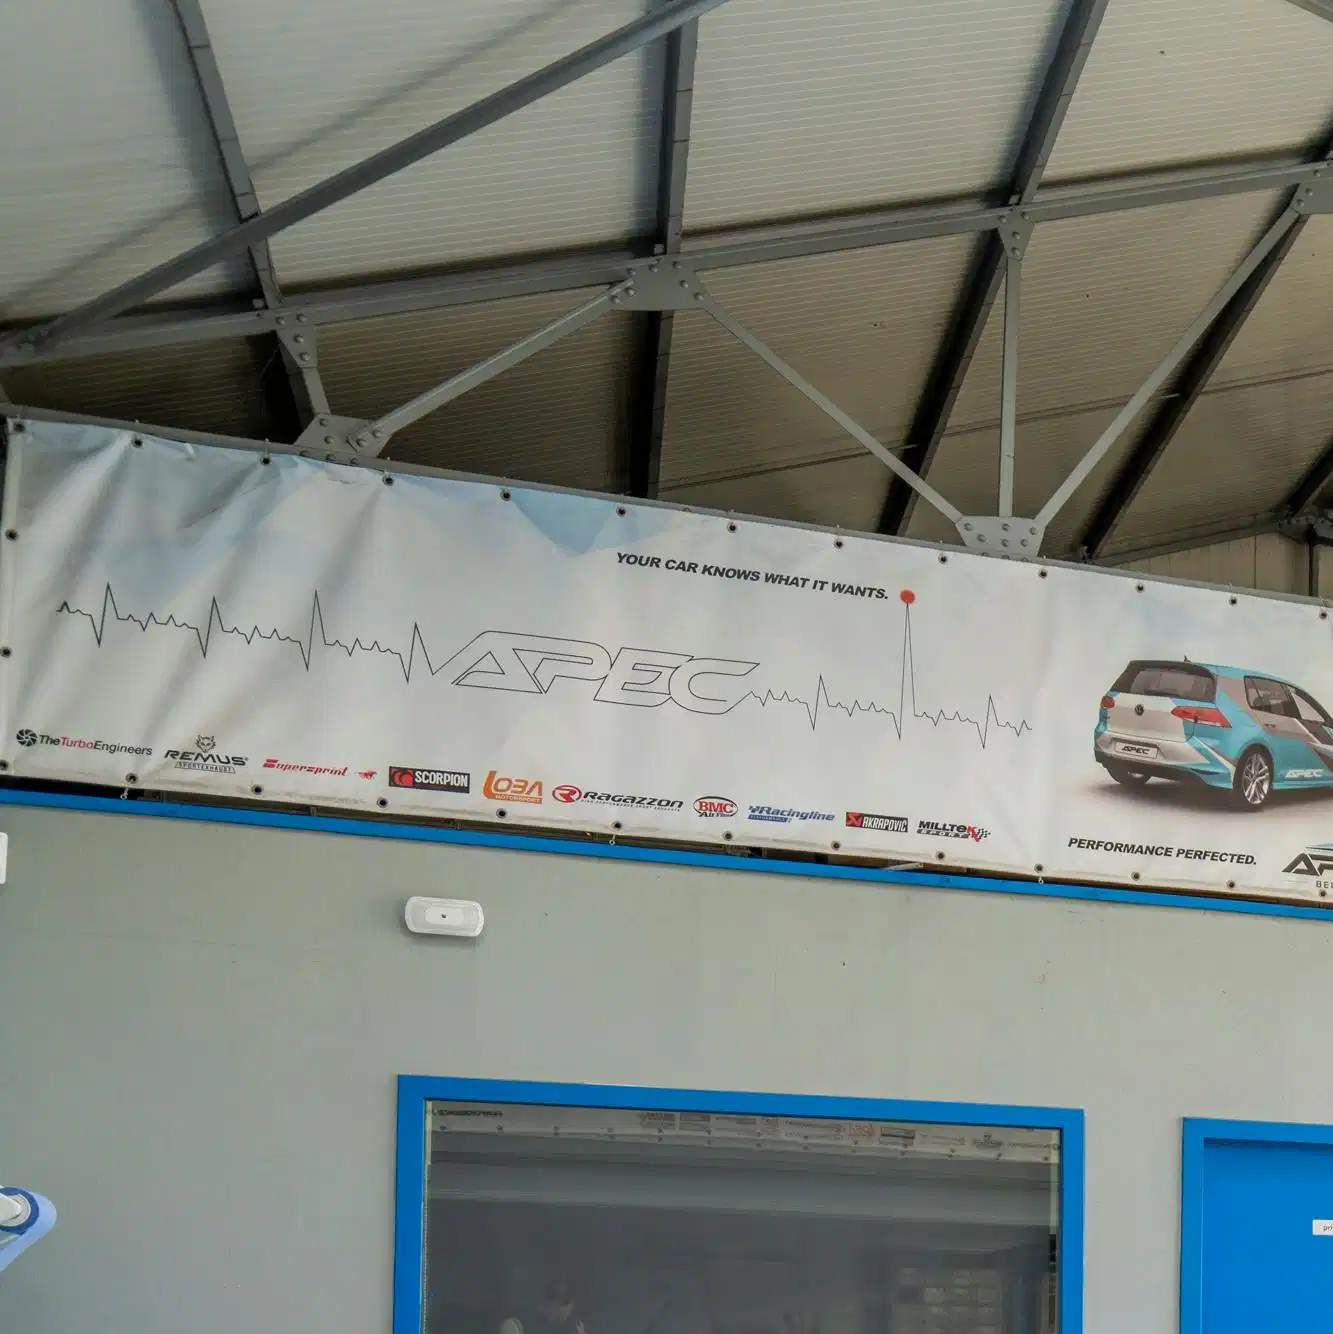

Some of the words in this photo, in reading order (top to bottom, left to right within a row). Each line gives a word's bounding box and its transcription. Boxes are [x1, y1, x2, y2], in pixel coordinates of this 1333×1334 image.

[616, 551, 662, 568] YOUR
[665, 559, 699, 574] CAR
[701, 564, 761, 582] KNOWS
[764, 572, 810, 589] WHAT
[812, 579, 829, 592] IT
[831, 582, 889, 600] WANTS.
[450, 630, 761, 715] APEC
[39, 734, 153, 756] TheTurboEngineers
[1121, 745, 1150, 755] APEC
[414, 769, 469, 788] SCORPION
[1284, 768, 1324, 779] APEC
[698, 800, 734, 814] BMC
[1068, 837, 1174, 857] PERFORMANCE
[1176, 847, 1257, 866] PERFECTED.
